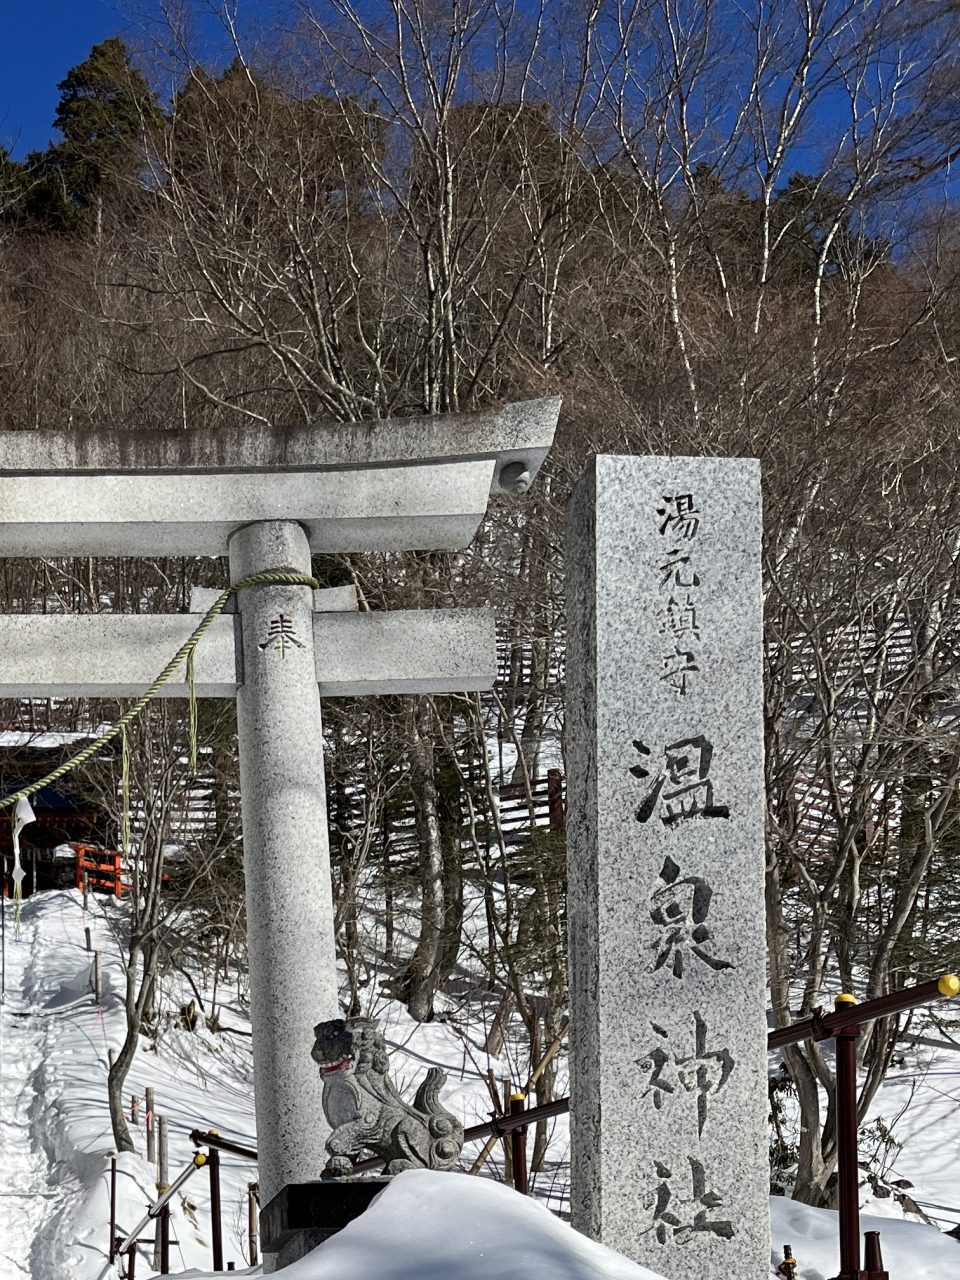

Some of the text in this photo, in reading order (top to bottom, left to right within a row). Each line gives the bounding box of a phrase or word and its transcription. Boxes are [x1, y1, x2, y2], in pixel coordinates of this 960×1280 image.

[257, 613, 307, 661] 奉
[629, 493, 737, 1246] 湯元鎮守 温泉神社
